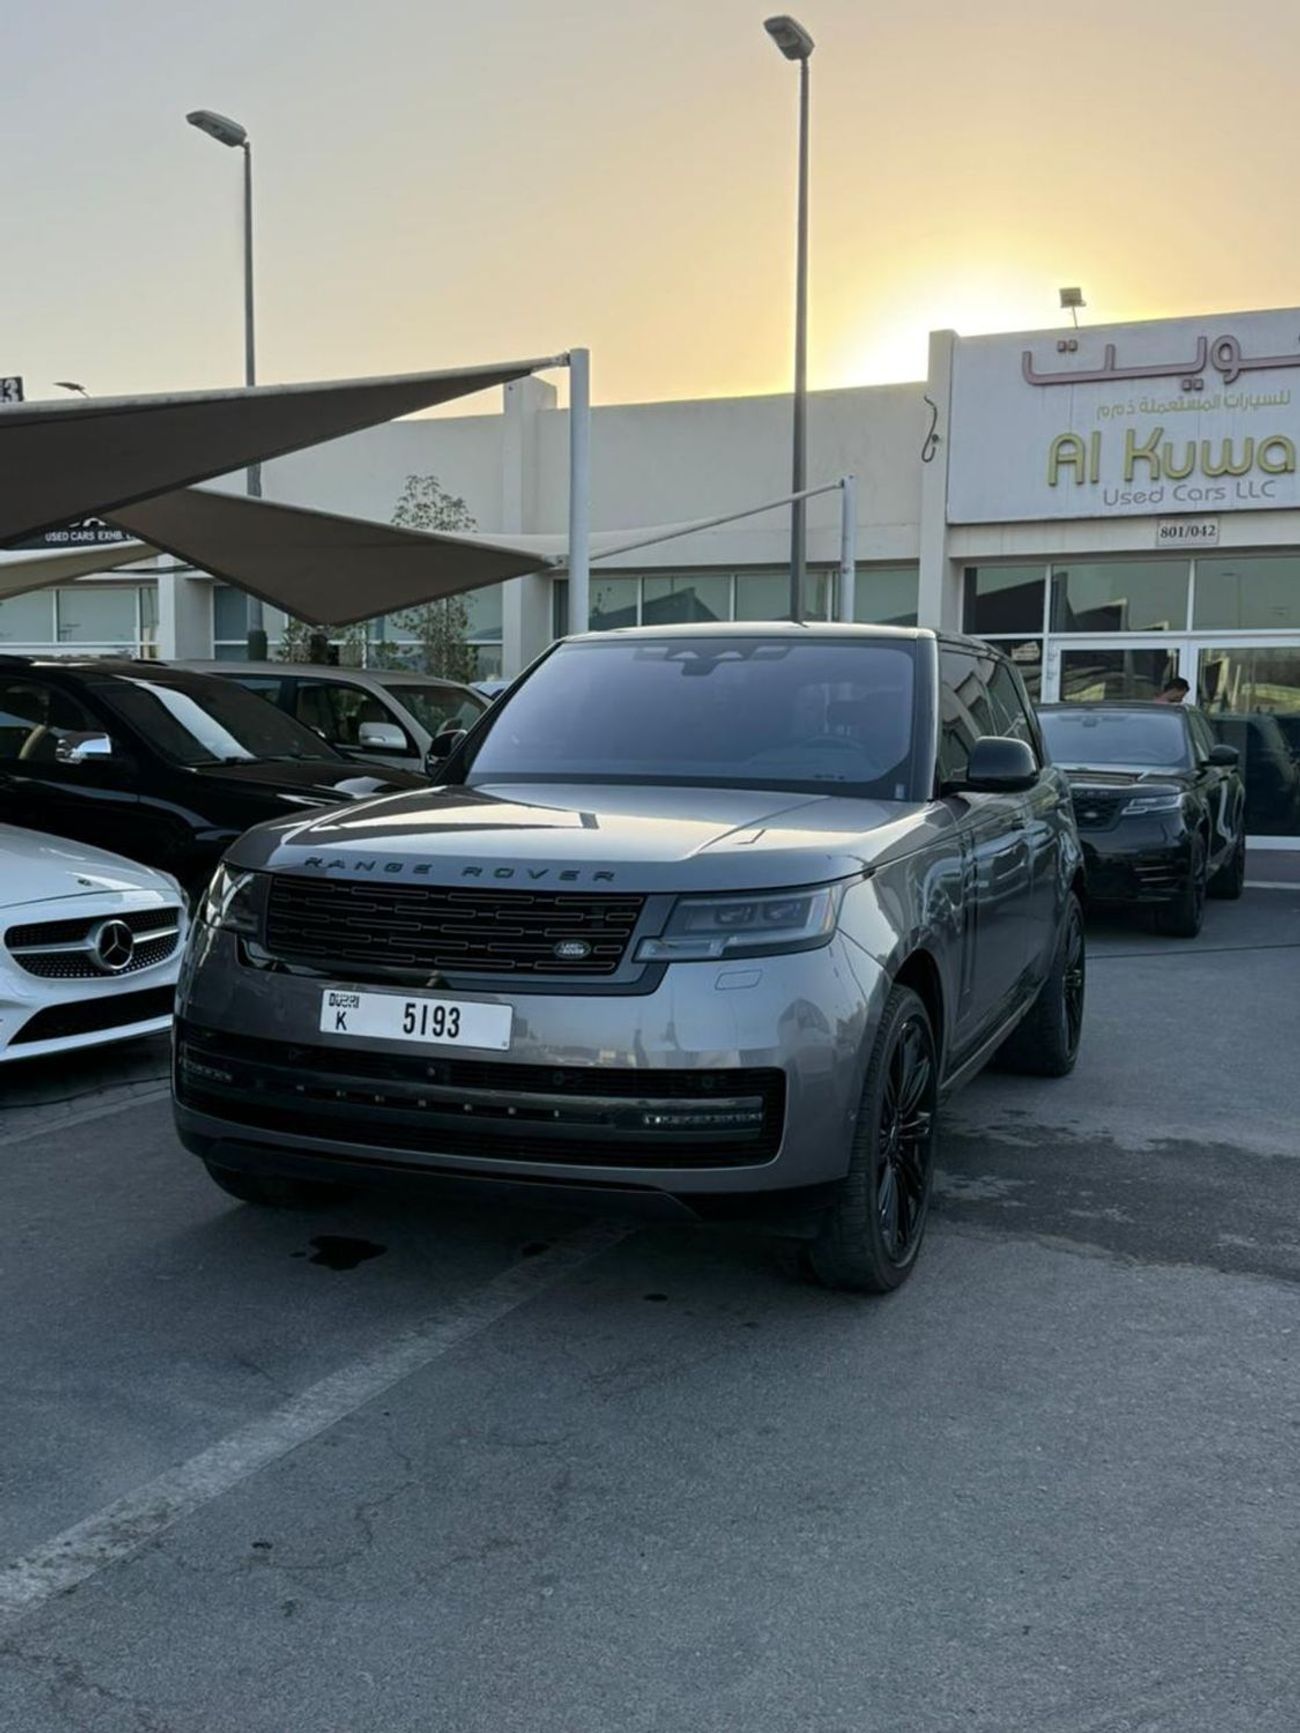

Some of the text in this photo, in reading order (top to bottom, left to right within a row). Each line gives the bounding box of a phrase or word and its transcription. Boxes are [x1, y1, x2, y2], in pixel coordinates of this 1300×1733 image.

[1022, 335, 1300, 391] ويت
[1047, 430, 1102, 487] Al
[1103, 480, 1276, 506] Used Cars LLC
[45, 531, 69, 542] USED
[70, 531, 95, 541] CARS
[1159, 525, 1216, 539] 801/042
[304, 856, 615, 882] RANGE ROVER
[335, 1002, 461, 1039] K 5193
